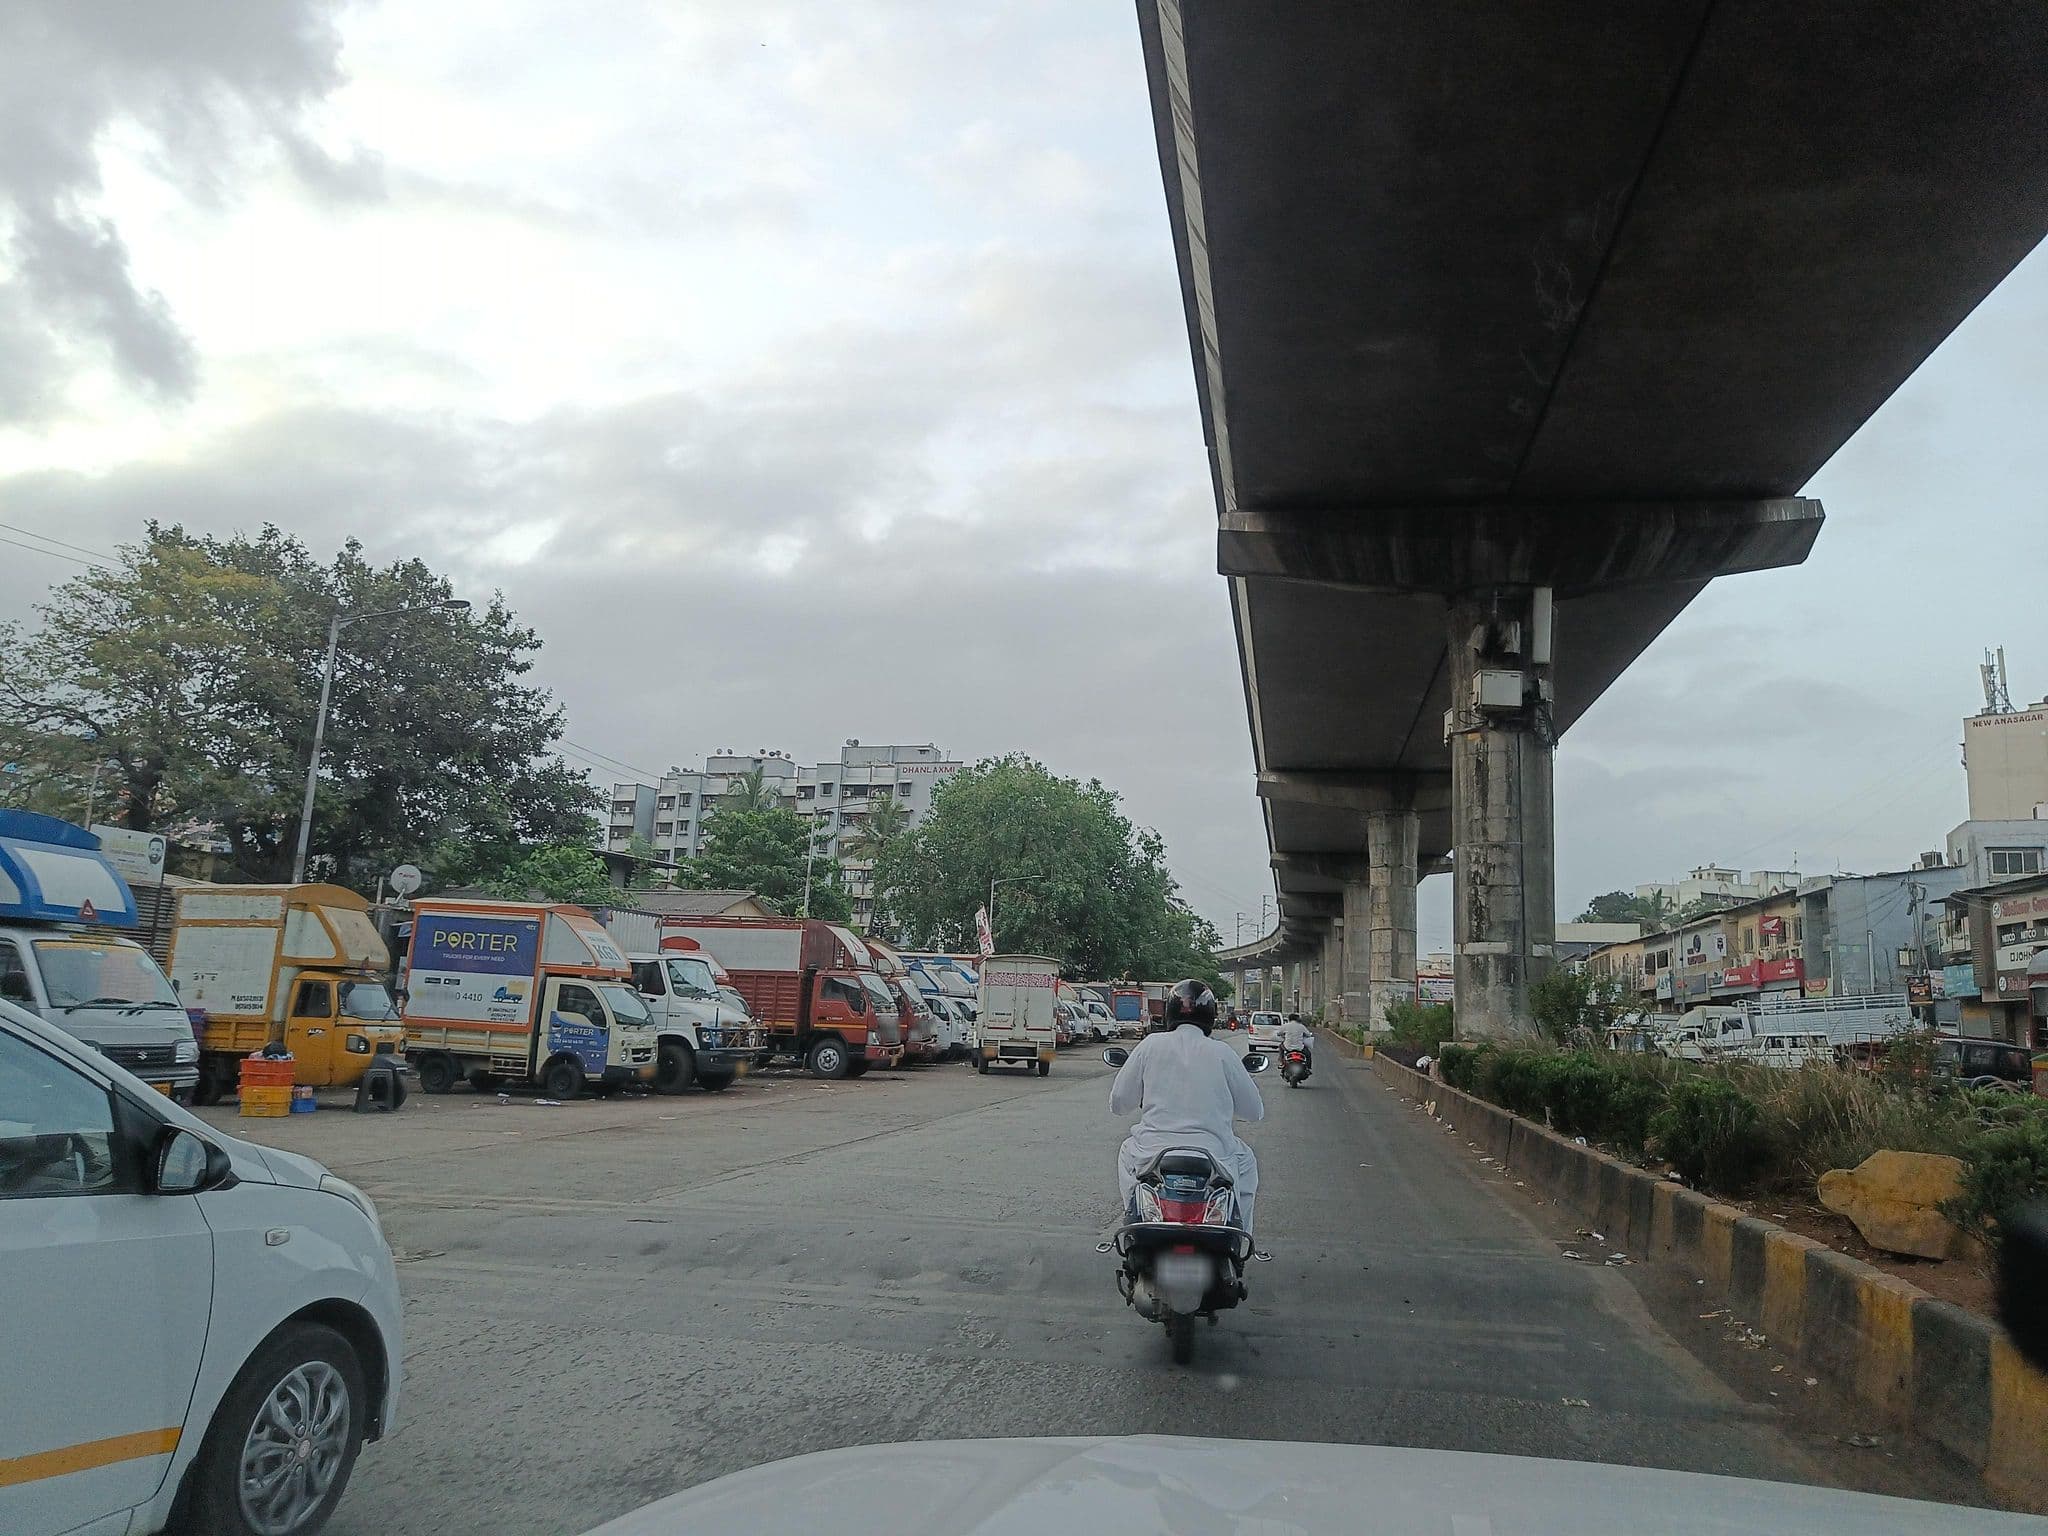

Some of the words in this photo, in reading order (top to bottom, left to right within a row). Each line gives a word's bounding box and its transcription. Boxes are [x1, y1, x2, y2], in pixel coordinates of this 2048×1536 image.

[1994, 714, 2044, 725] ANASAGAR
[433, 930, 518, 952] PORTER
[462, 992, 483, 1002] 4410
[563, 1027, 594, 1036] PORTER
